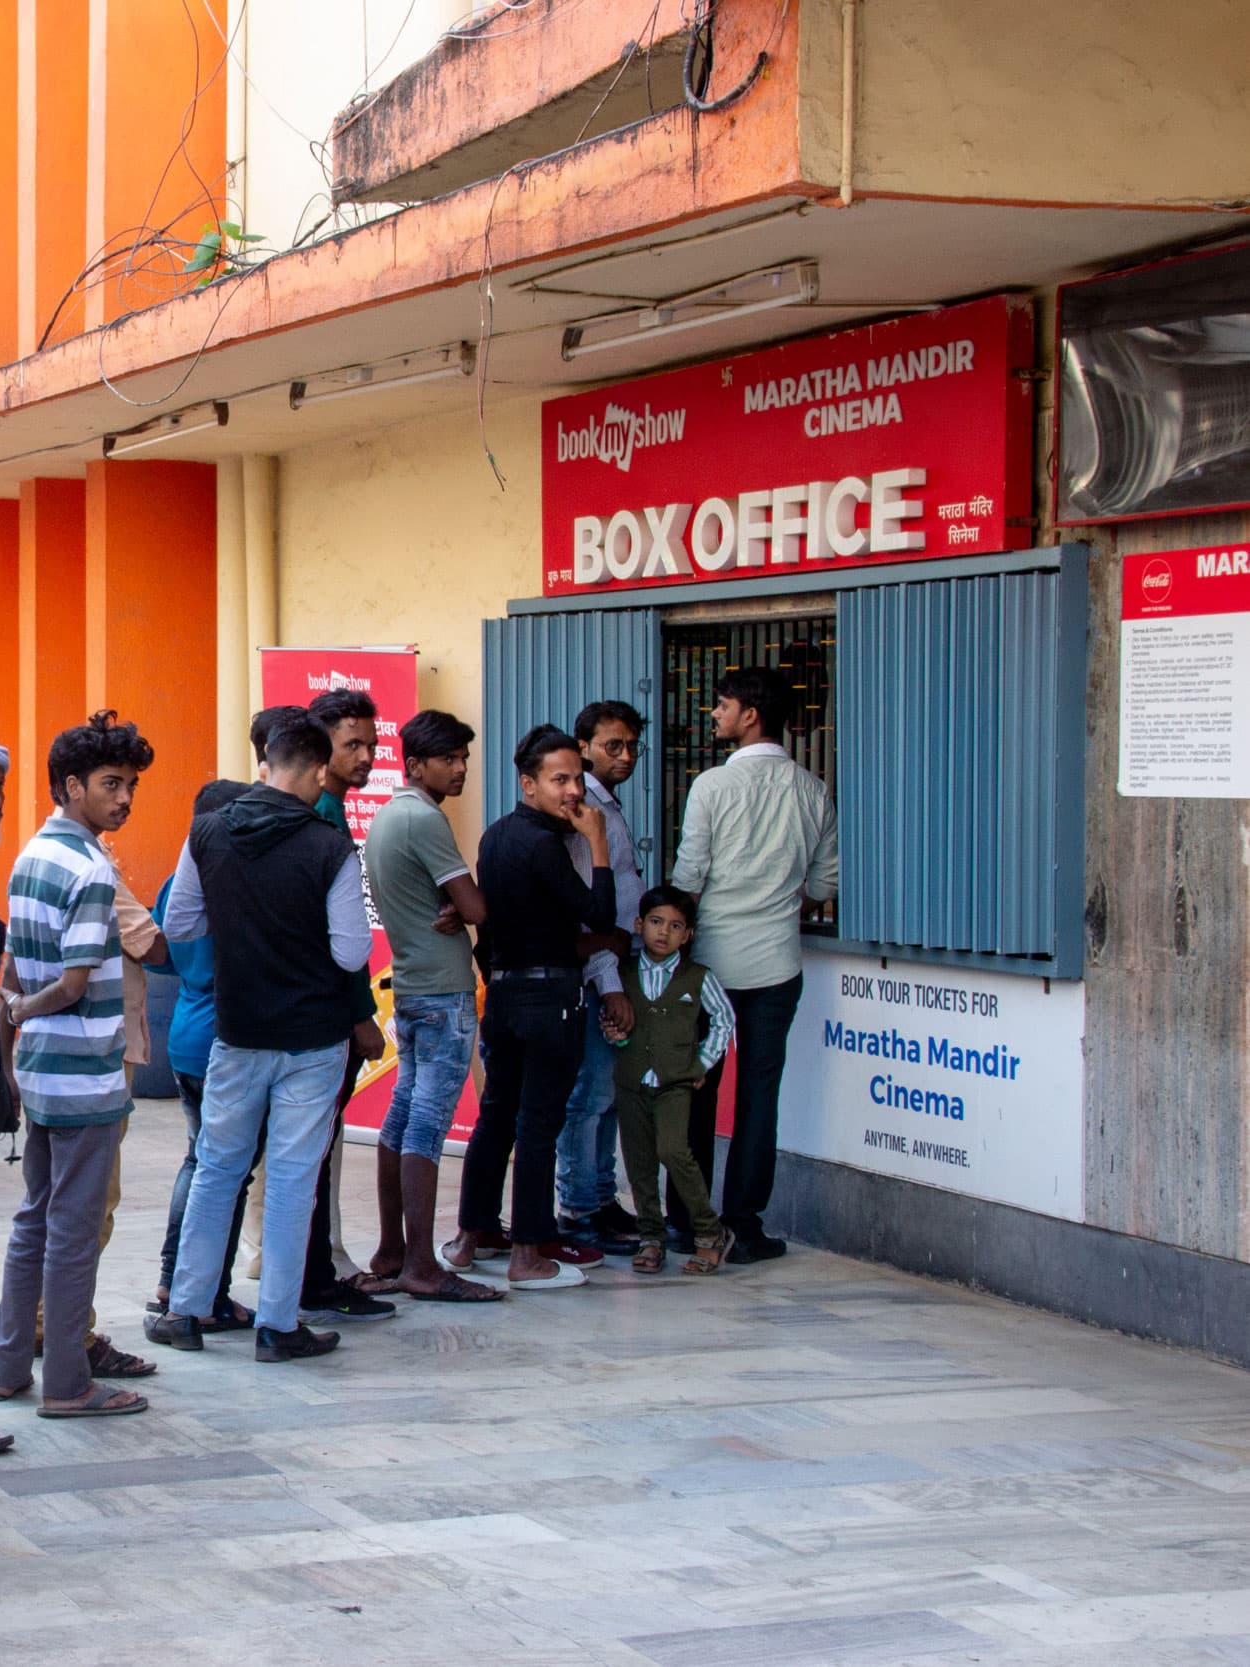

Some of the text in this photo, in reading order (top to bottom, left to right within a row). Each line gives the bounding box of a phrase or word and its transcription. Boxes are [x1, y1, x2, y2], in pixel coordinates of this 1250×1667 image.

[744, 340, 975, 414] MARATHA MANDIR
[804, 393, 903, 438] CINEMA
[574, 468, 927, 585] BOX OFFICE
[938, 495, 993, 520] मराठा मंदिर
[948, 523, 979, 544] सिनेमा
[842, 974, 998, 1018] BOOK YOUR TICKETS FOR
[824, 1019, 1020, 1080] Maratha Mandir
[870, 1075, 965, 1121] Cinema
[864, 1129, 970, 1169] ANYTIME, ANYWHERE.
